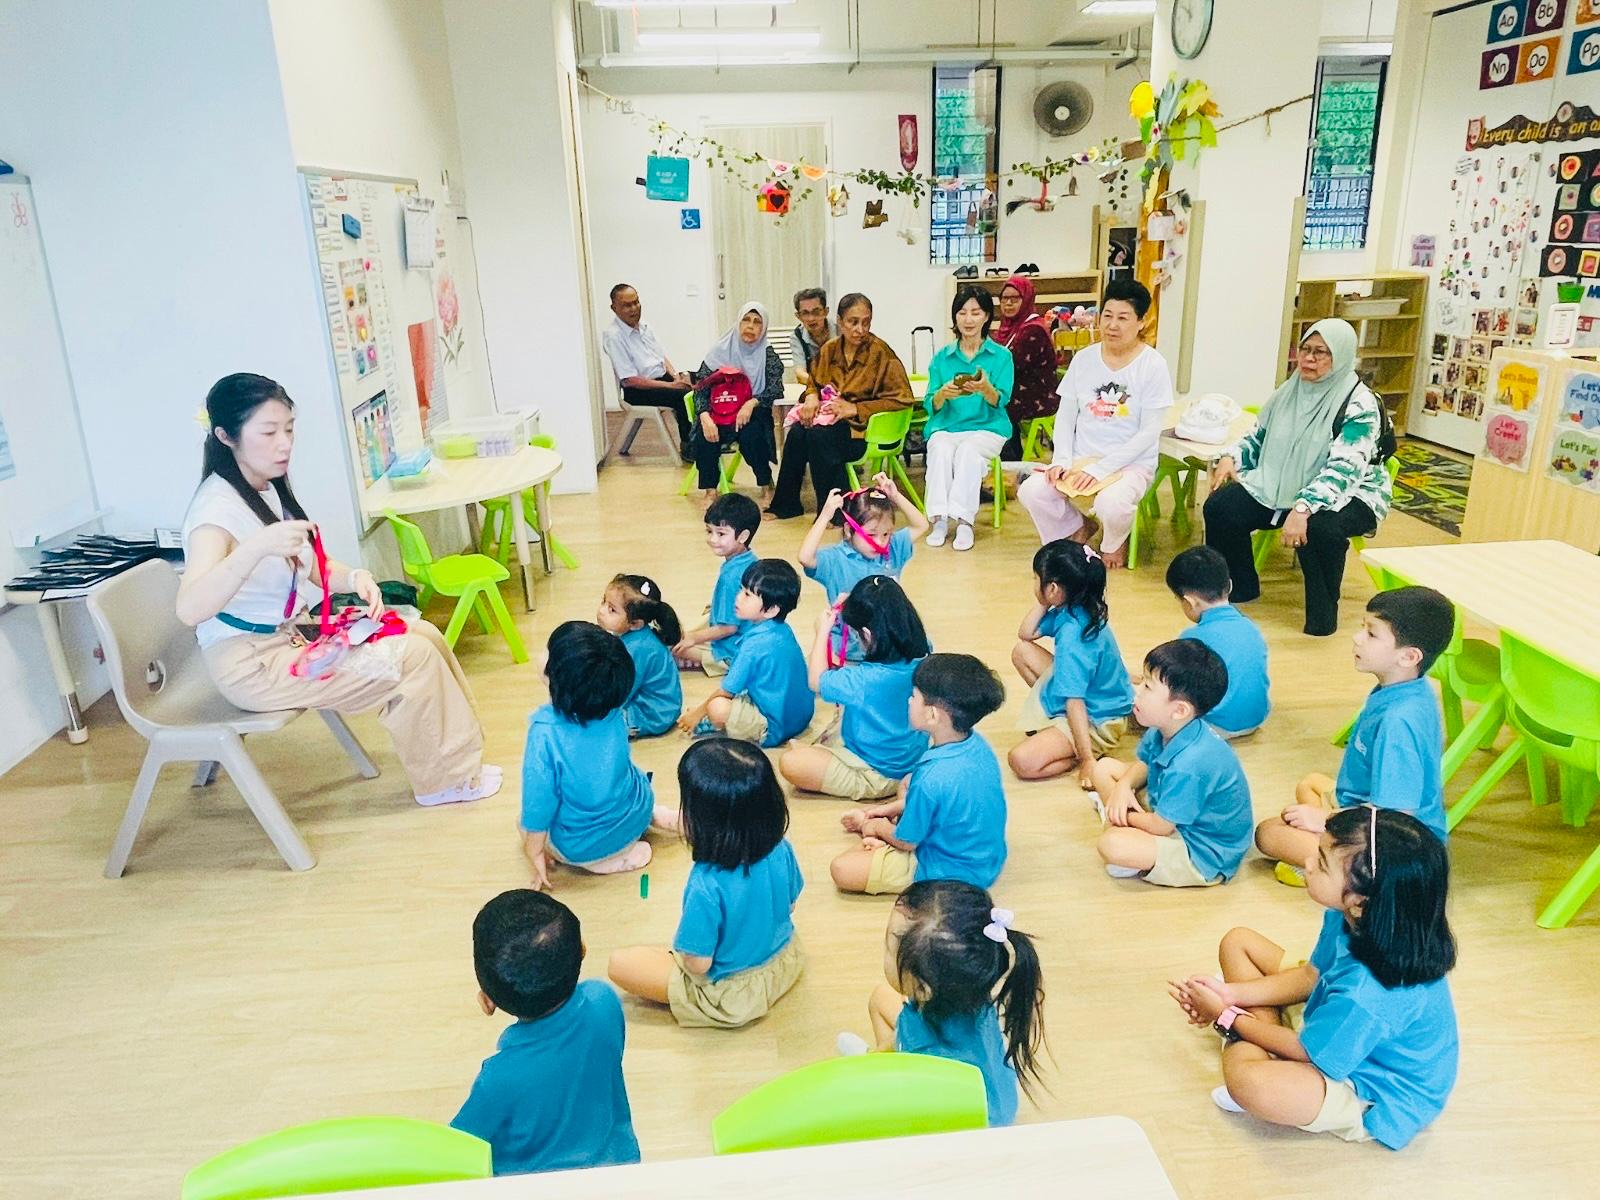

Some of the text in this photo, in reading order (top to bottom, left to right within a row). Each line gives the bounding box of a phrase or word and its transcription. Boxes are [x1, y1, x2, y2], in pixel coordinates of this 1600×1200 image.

[1537, 4, 1554, 20] Bb
[1499, 14, 1515, 28] Aa
[1582, 42, 1600, 61] Pp
[1492, 62, 1506, 74] Nn
[1529, 54, 1546, 68] Oo
[1483, 128, 1515, 143] Every
[1518, 122, 1549, 140] child
[1549, 123, 1561, 138] is
[1568, 122, 1587, 135] an
[1569, 389, 1589, 401] Find
[1560, 439, 1579, 452] Let's
